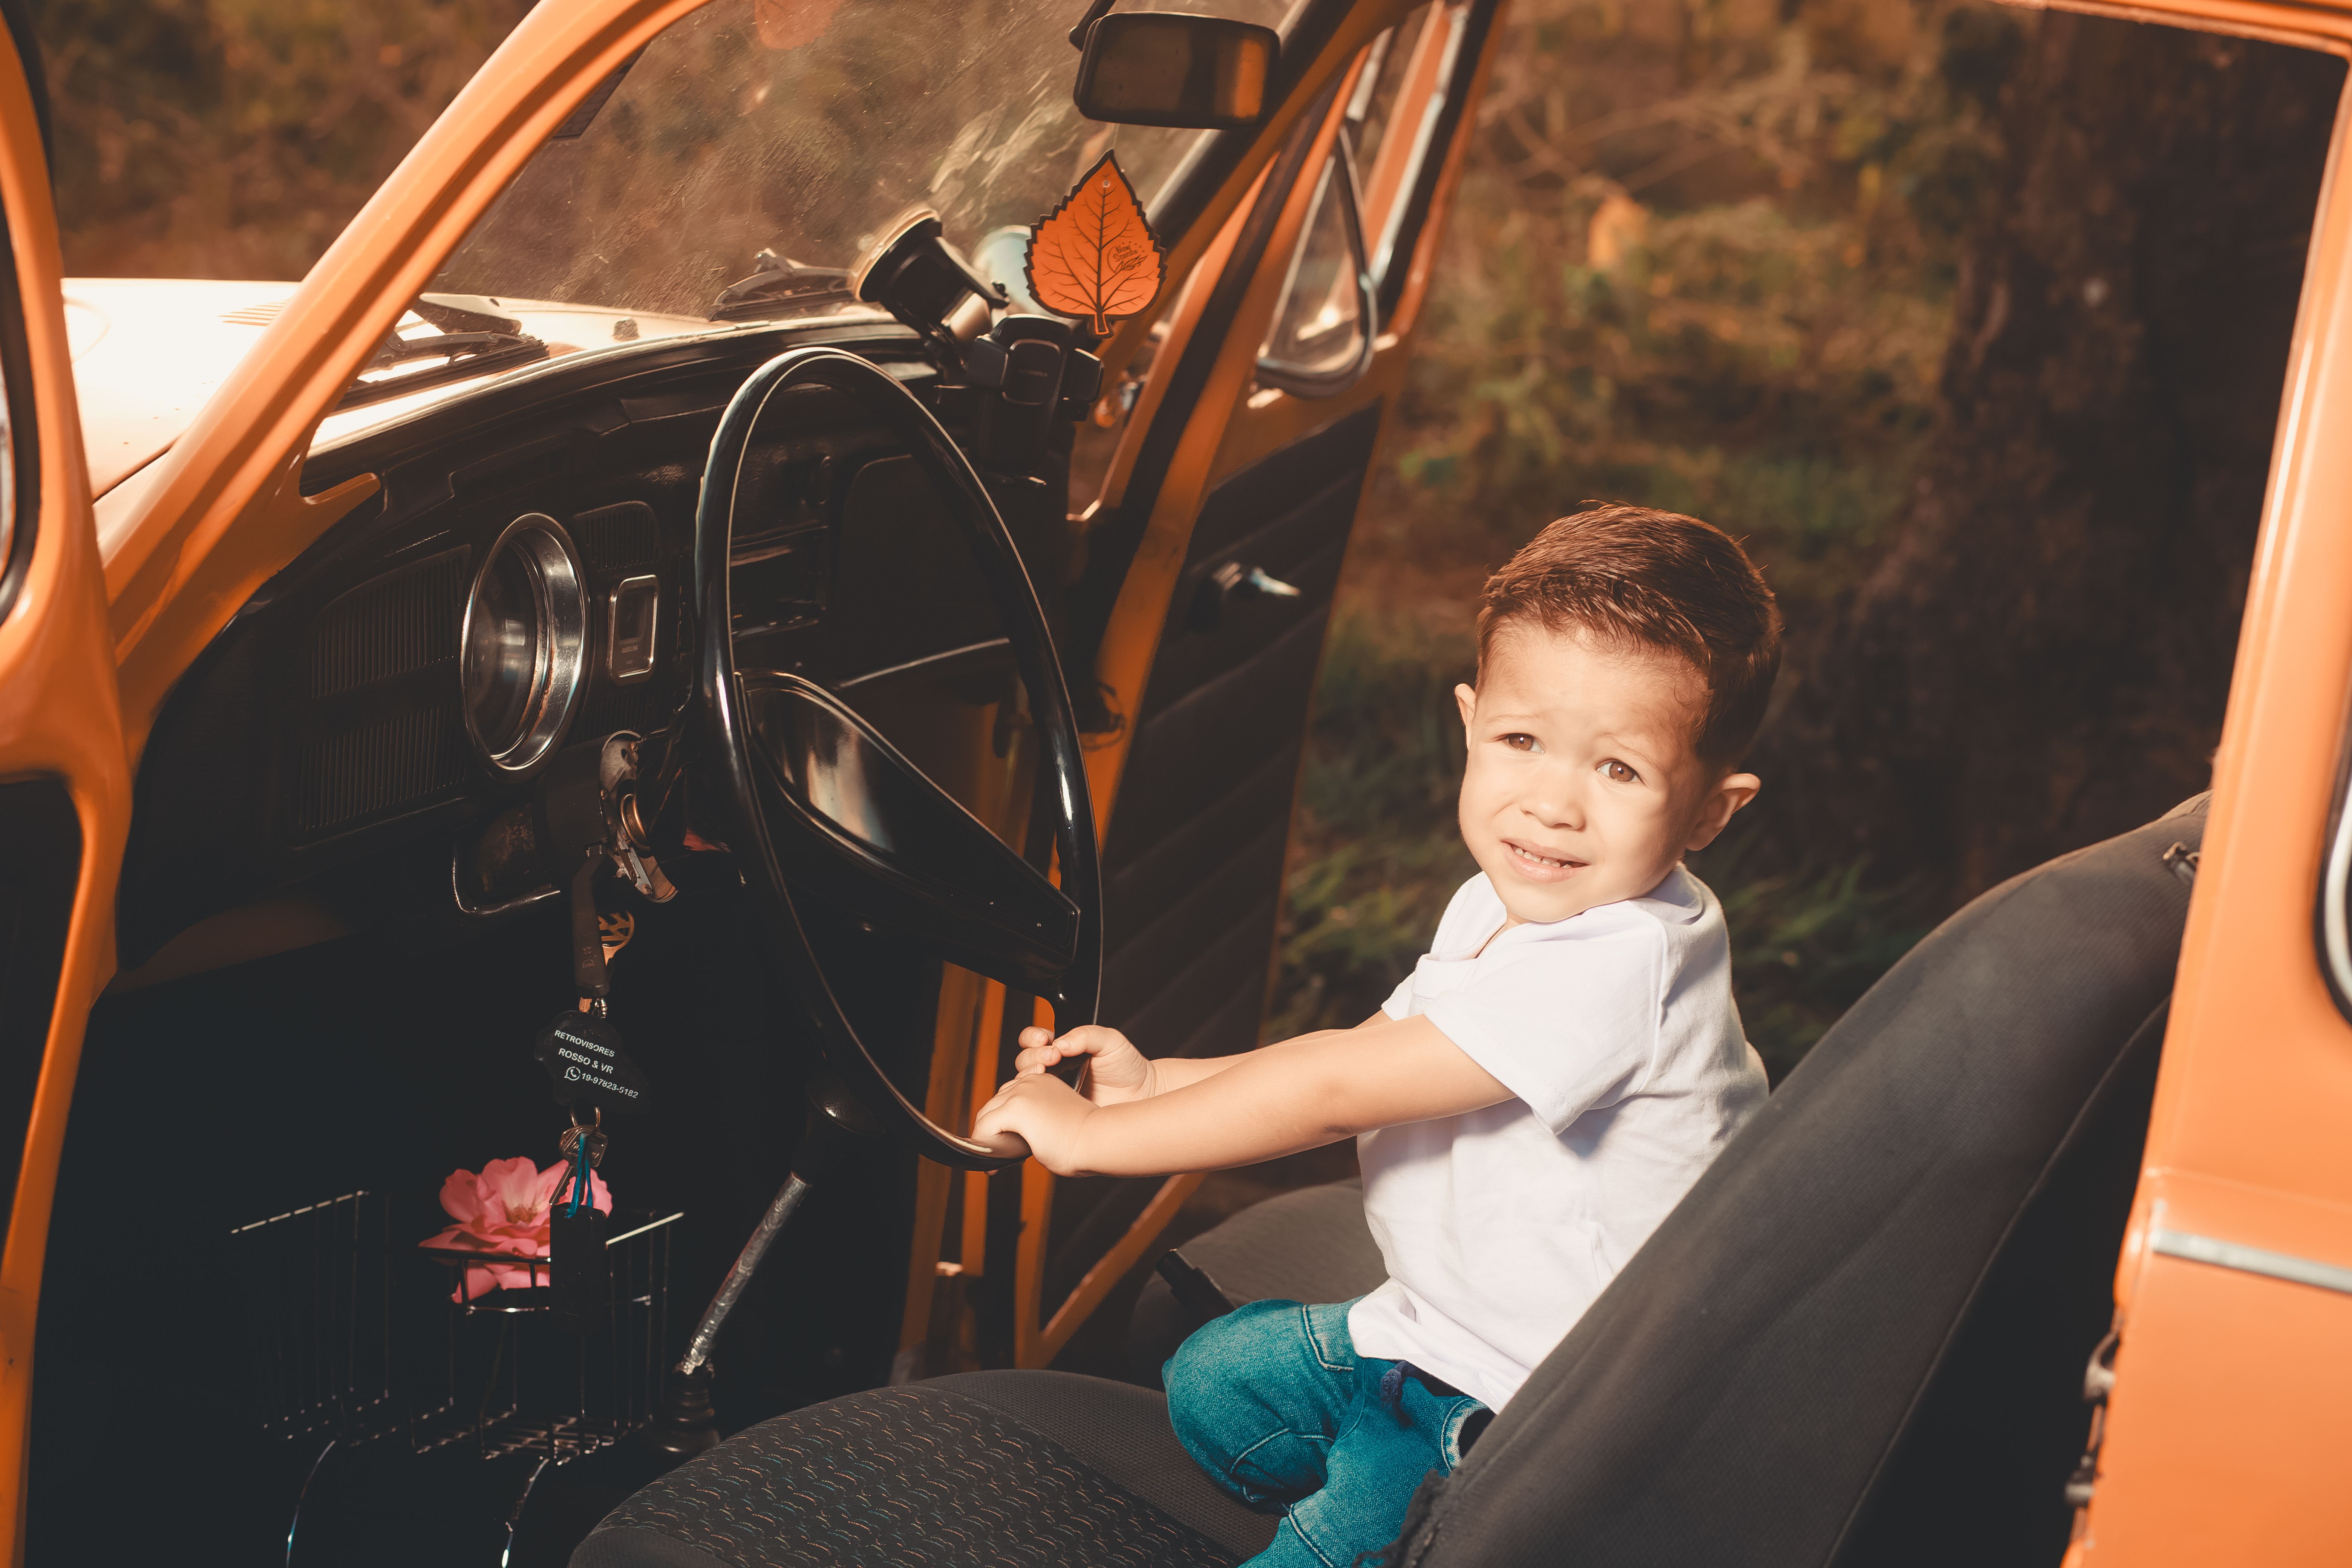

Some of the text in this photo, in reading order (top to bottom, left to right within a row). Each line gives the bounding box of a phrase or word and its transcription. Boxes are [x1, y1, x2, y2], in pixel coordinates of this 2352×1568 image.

[1116, 245, 1130, 253] New
[554, 1030, 615, 1057] RETROVISORES
[558, 1048, 613, 1074] ROSSO & VR
[582, 1073, 639, 1098] 19-97823-5182
